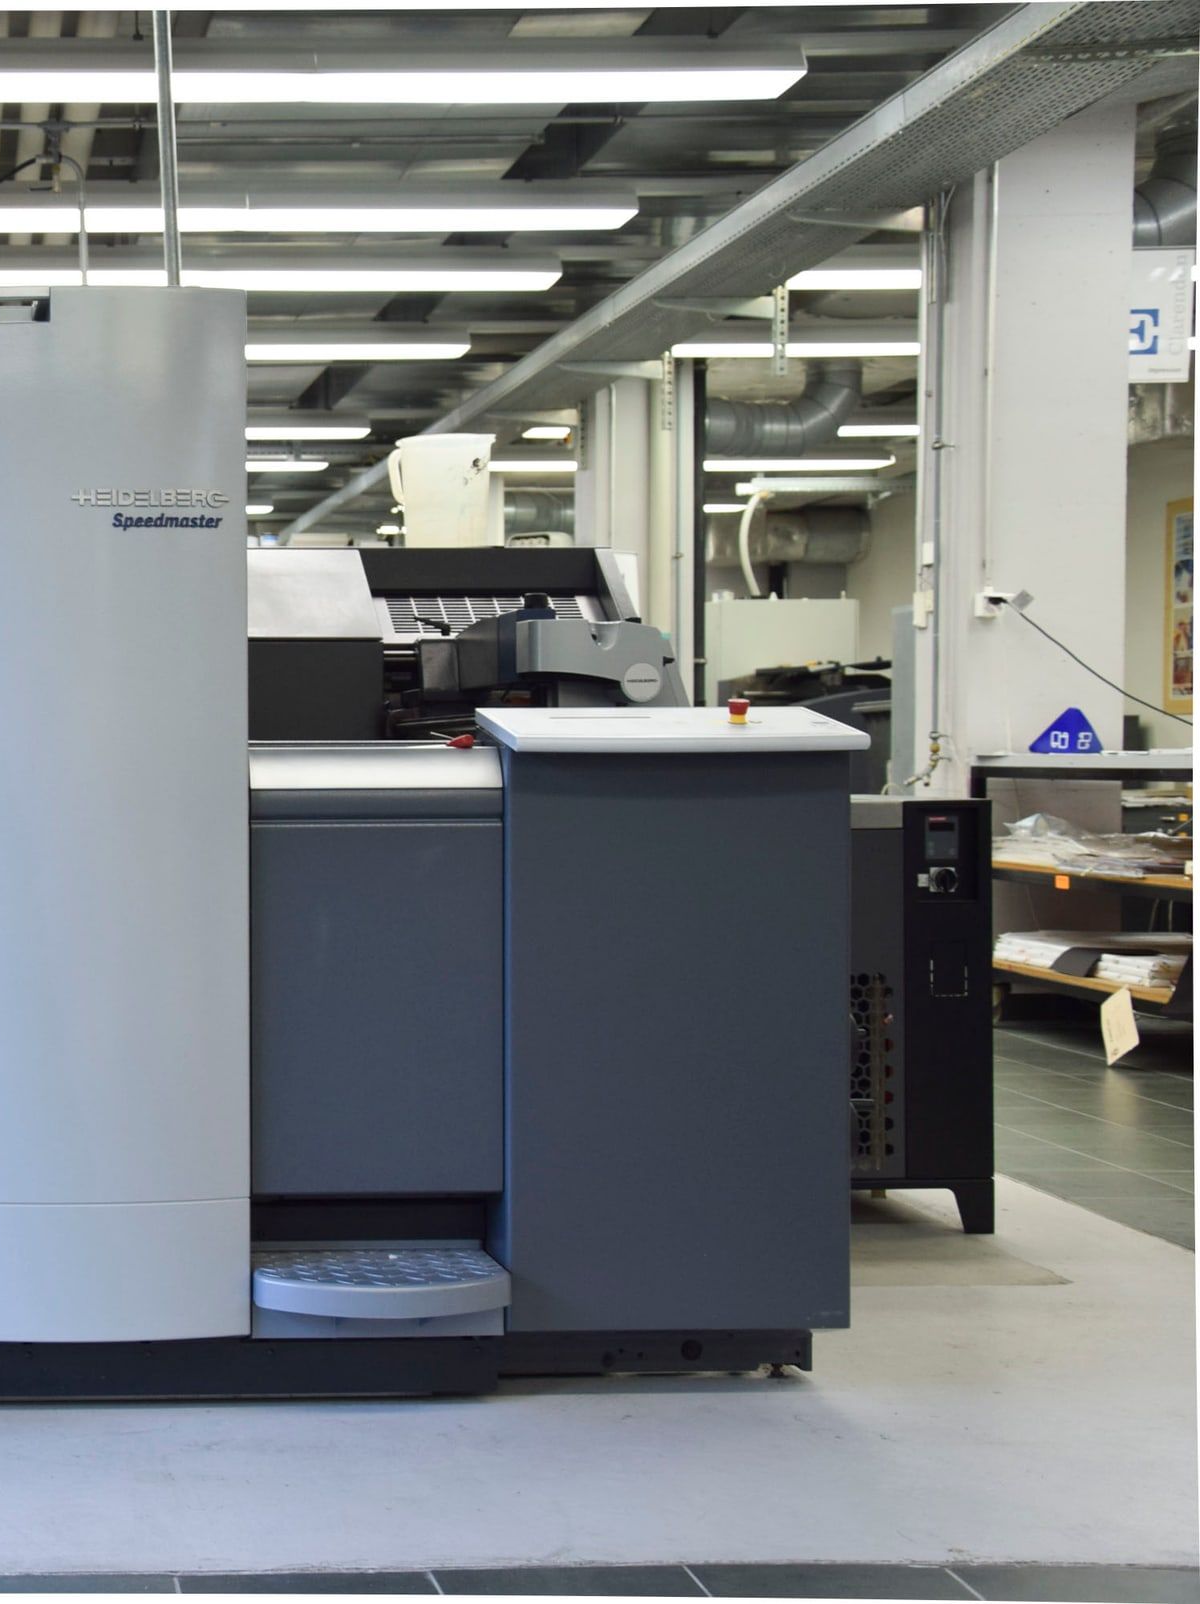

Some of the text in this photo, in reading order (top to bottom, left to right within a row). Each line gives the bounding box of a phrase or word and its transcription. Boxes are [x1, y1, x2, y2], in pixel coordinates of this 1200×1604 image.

[1168, 254, 1186, 356] Clarendn
[71, 488, 229, 509] HEIDELBERG
[112, 512, 223, 531] Speedmaster
